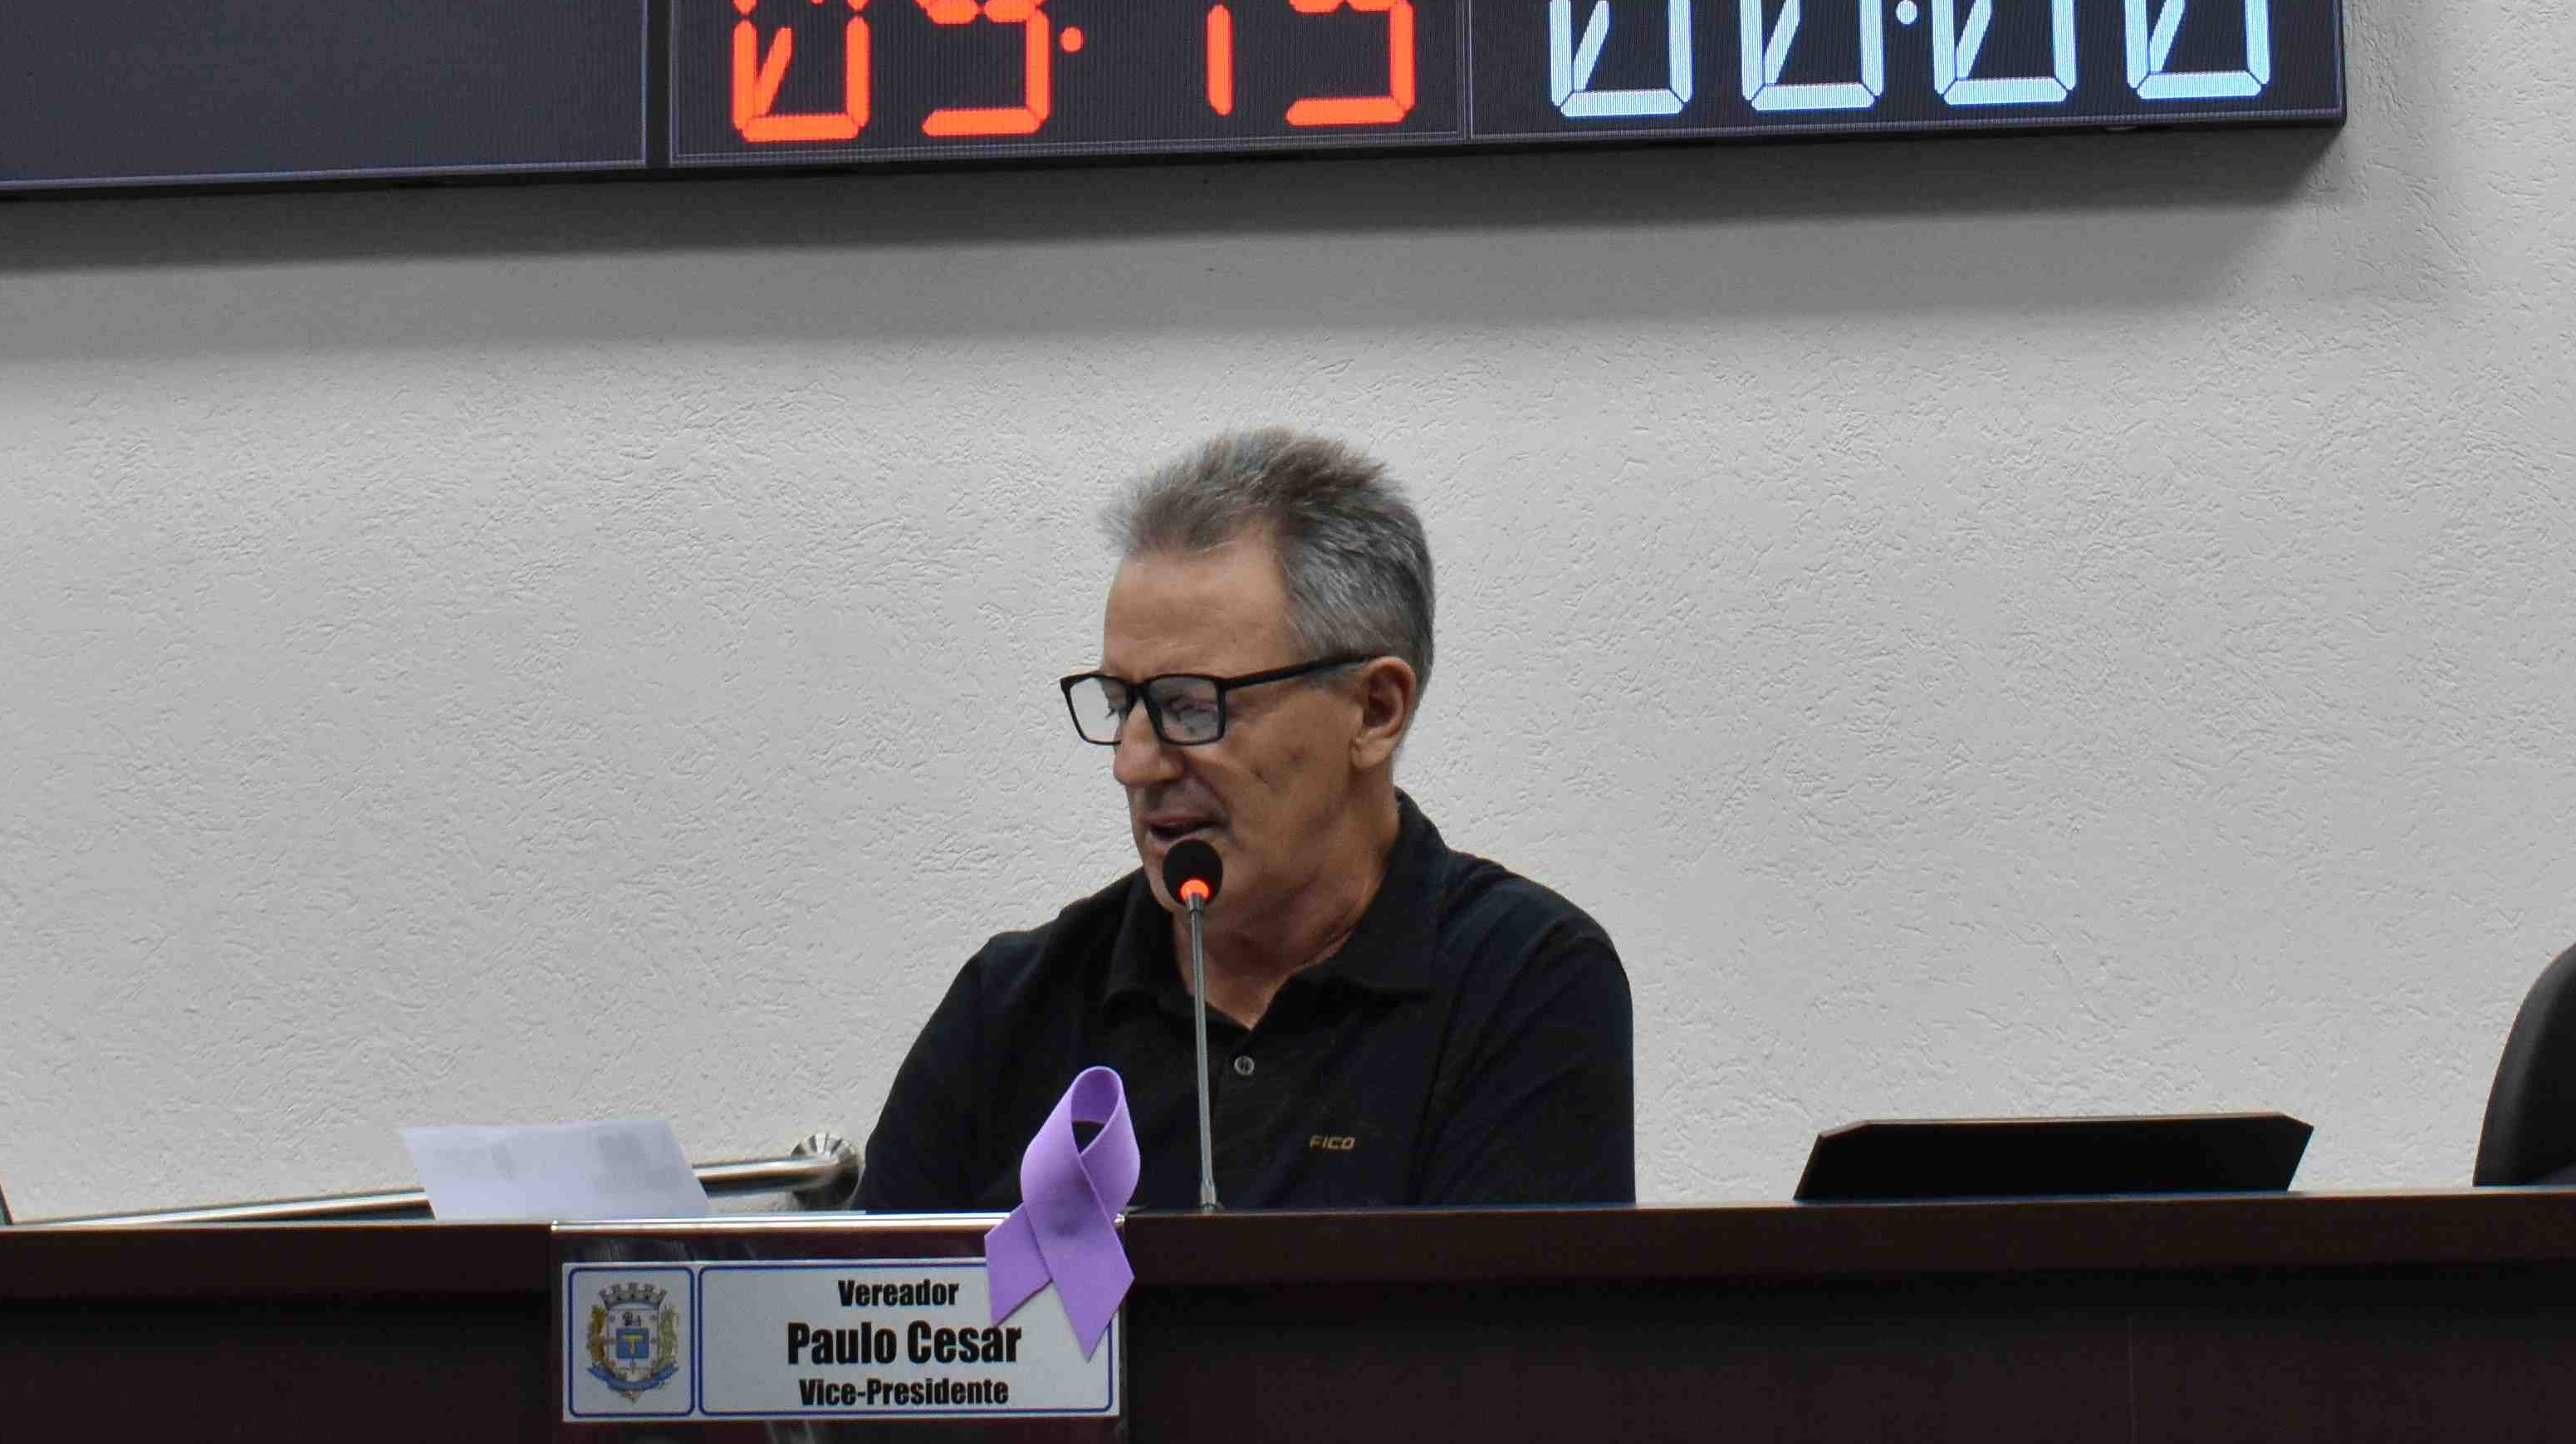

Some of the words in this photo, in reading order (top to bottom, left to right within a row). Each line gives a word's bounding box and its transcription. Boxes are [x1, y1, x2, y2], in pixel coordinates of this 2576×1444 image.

[1310, 1134, 1356, 1150] FICO
[837, 1279, 960, 1307] Vereador
[787, 1321, 898, 1365] Paulo
[907, 1320, 1022, 1364] Cesar
[798, 1378, 1010, 1406] Vice-Presidente
